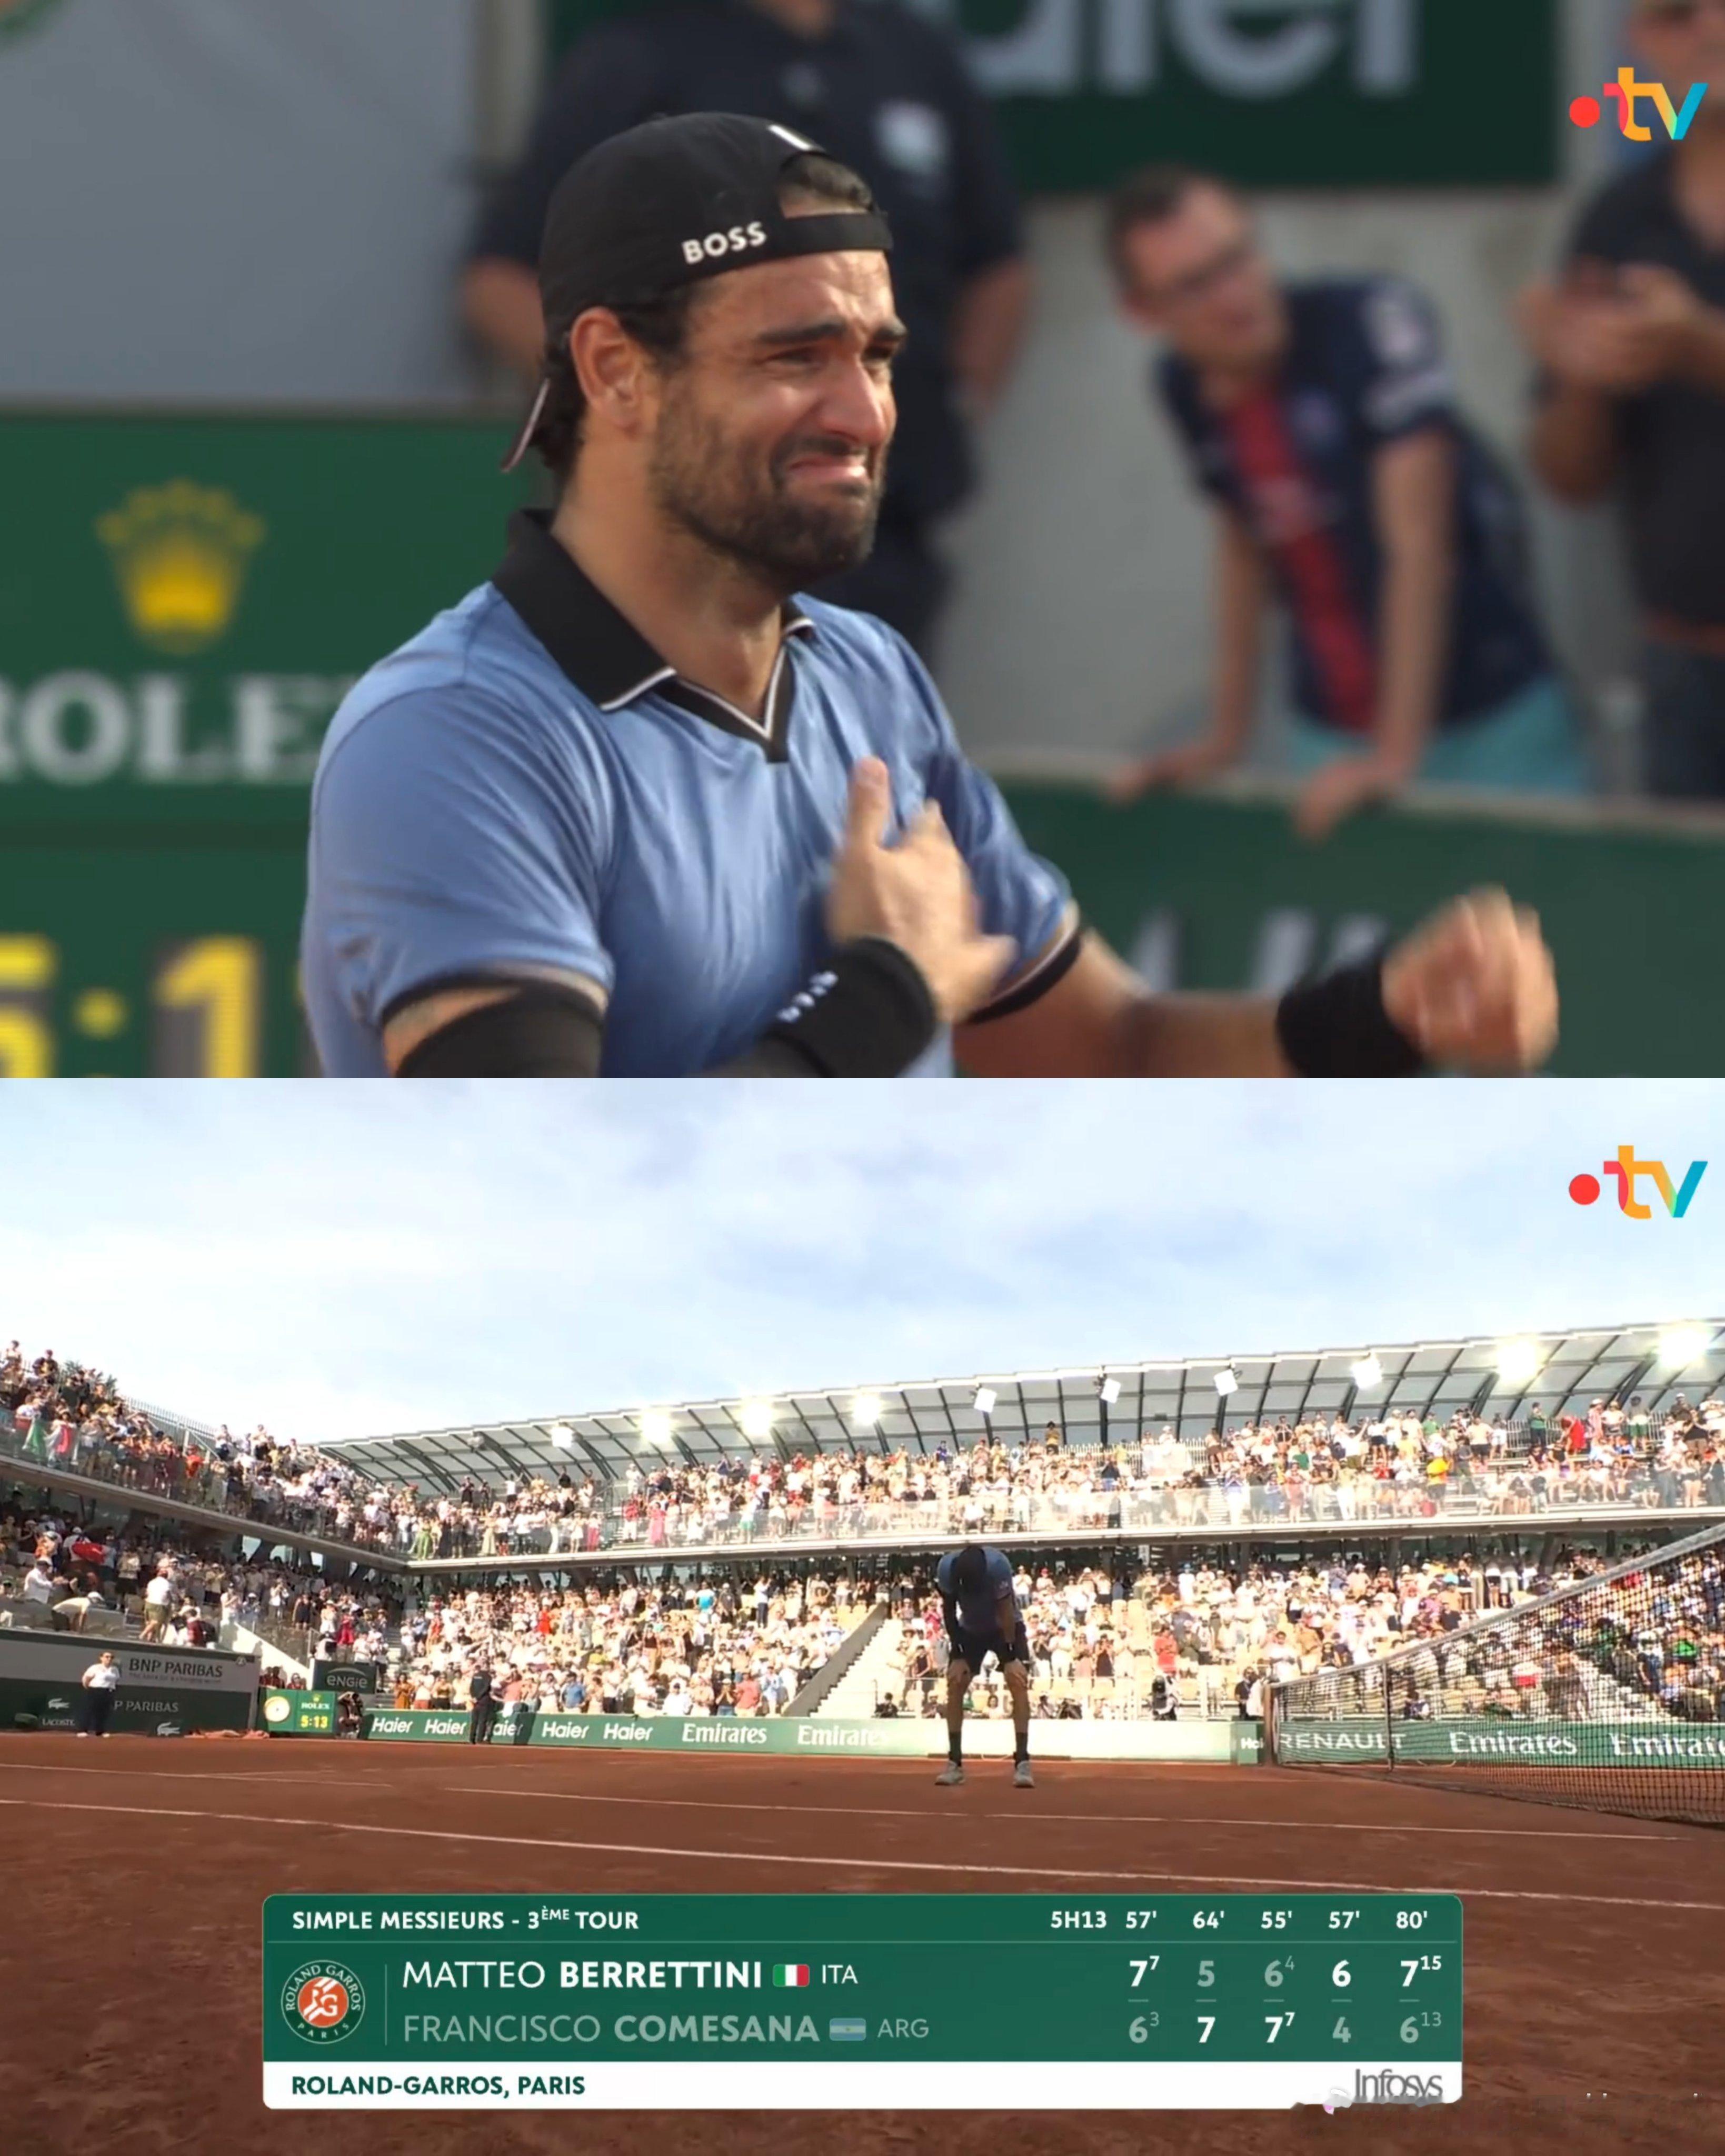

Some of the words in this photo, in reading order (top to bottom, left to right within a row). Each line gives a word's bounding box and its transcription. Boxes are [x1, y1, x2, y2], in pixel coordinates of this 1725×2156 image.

[682, 222, 767, 264] BOSS
[129, 1659, 162, 1672] BNP
[165, 1662, 223, 1678] PARIBAS
[126, 1701, 179, 1712] PARIBAS
[301, 1715, 327, 1729] 5:13
[372, 1717, 413, 1734] Haier
[425, 1719, 466, 1736] Haier
[493, 1719, 523, 1736] aier
[542, 1721, 589, 1739] Haier
[604, 1722, 653, 1741] Haier
[683, 1723, 767, 1744] Emirates
[1280, 1733, 1407, 1749] RENAULT
[1450, 1731, 1578, 1755] Emirates
